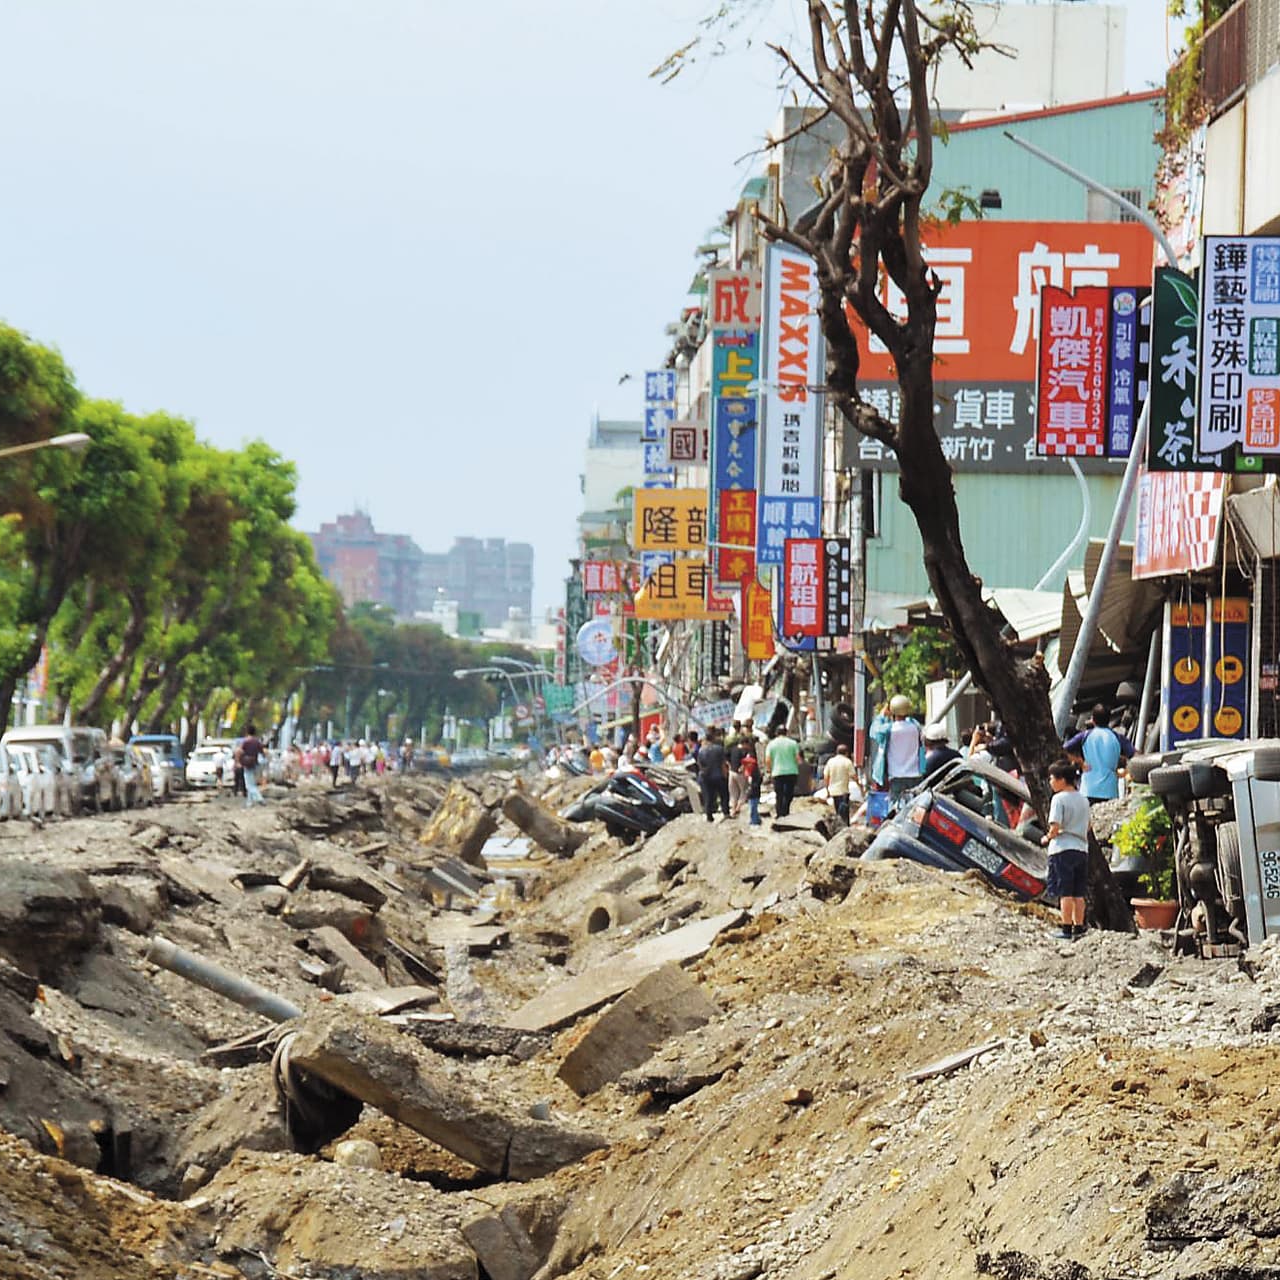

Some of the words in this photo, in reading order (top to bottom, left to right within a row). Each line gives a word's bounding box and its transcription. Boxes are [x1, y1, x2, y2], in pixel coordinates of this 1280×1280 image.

[778, 258, 811, 404] MAXXIS
[1047, 306, 1092, 431] 凱傑汽車
